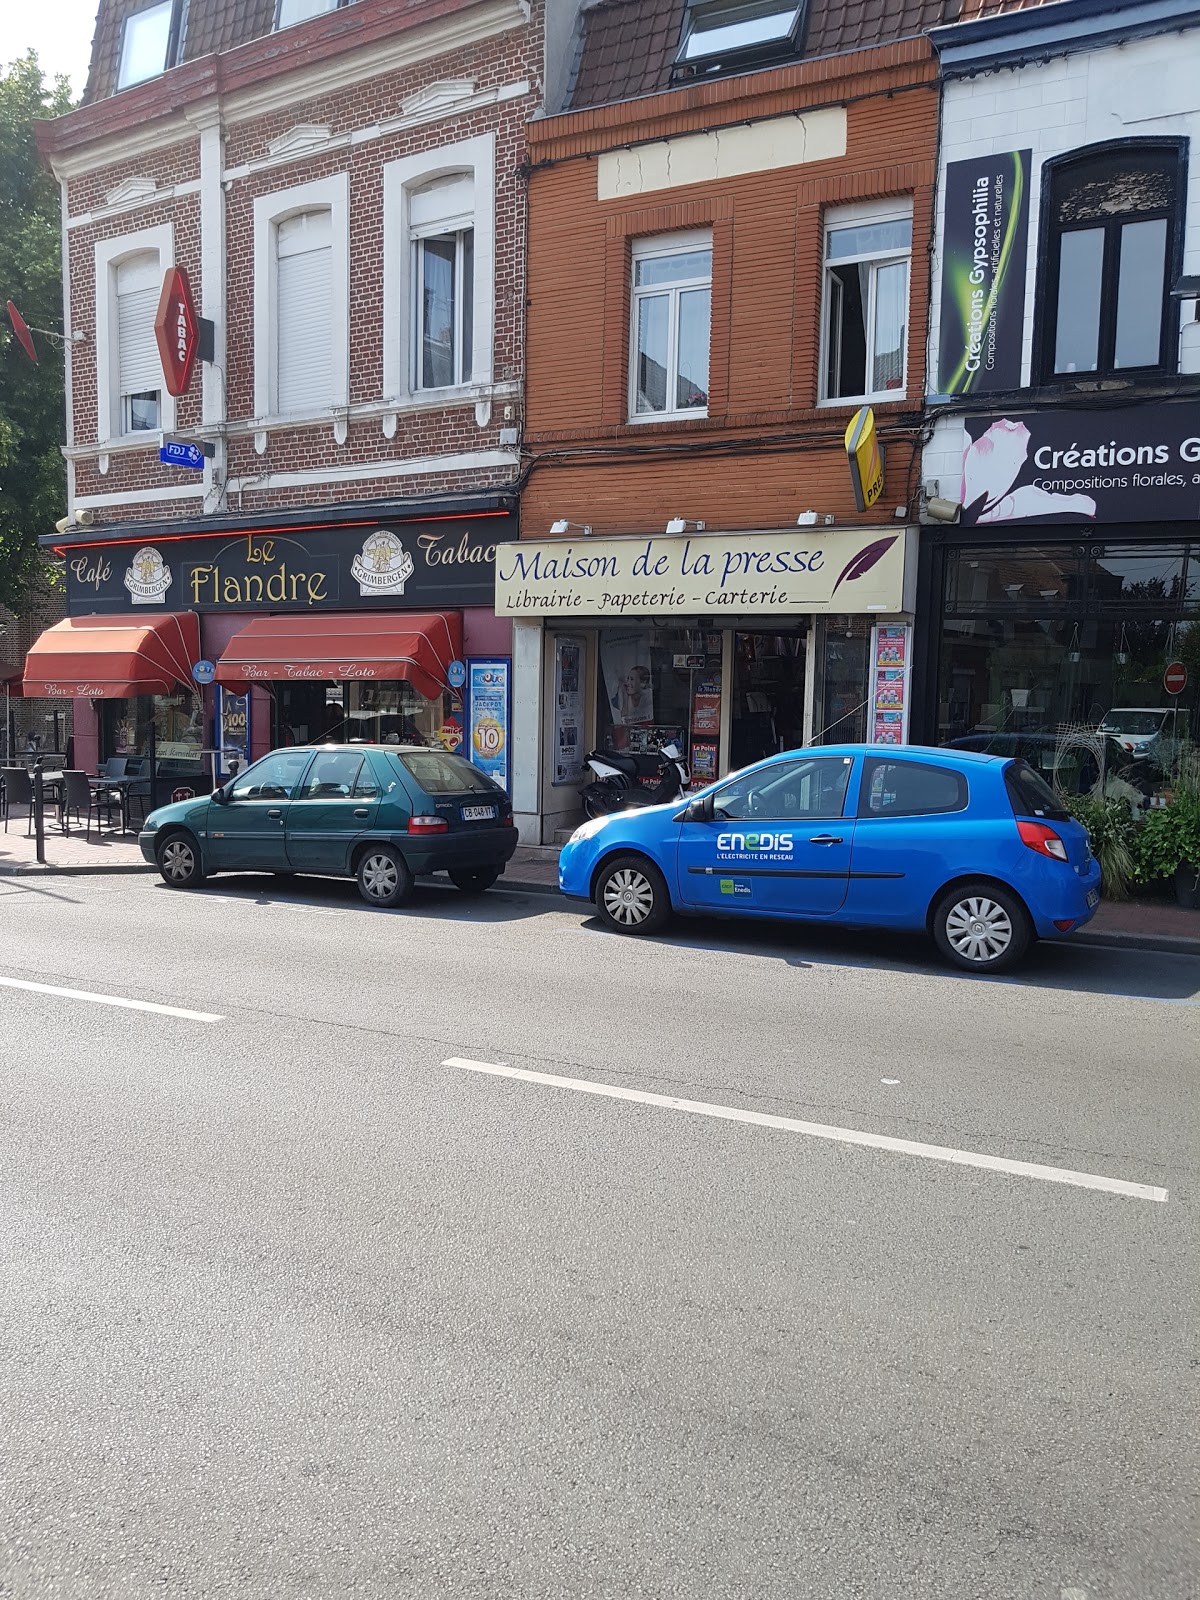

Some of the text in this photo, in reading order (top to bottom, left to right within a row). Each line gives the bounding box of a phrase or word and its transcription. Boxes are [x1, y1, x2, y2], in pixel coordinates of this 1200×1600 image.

[993, 174, 1004, 216] naturelles
[993, 219, 1002, 227] et
[990, 228, 1002, 274] artificielles
[177, 302, 188, 362] TABAC
[965, 289, 984, 372] Créations
[985, 310, 997, 371] Compositions
[169, 444, 186, 456] FDJ
[1034, 440, 1170, 470] Créations
[1032, 478, 1128, 492] Compositions
[1132, 472, 1187, 487] florales,
[246, 534, 276, 565] Le
[416, 531, 496, 567] Tabac
[500, 540, 825, 588] Maison de la presse
[70, 555, 113, 591] Café
[127, 580, 168, 594] GRIMBERGEN
[190, 562, 328, 605] Flandre
[357, 566, 408, 585] GRIMBERGEN
[506, 589, 582, 609] Librairie
[597, 587, 686, 613] Papeterie
[704, 585, 788, 606] Carterie
[241, 665, 270, 678] Bar
[283, 664, 323, 678] Tabac
[338, 664, 378, 678] Loto
[45, 684, 68, 697] Bar
[76, 685, 105, 697] Loto
[227, 712, 246, 727] 100
[478, 728, 500, 750] 10
